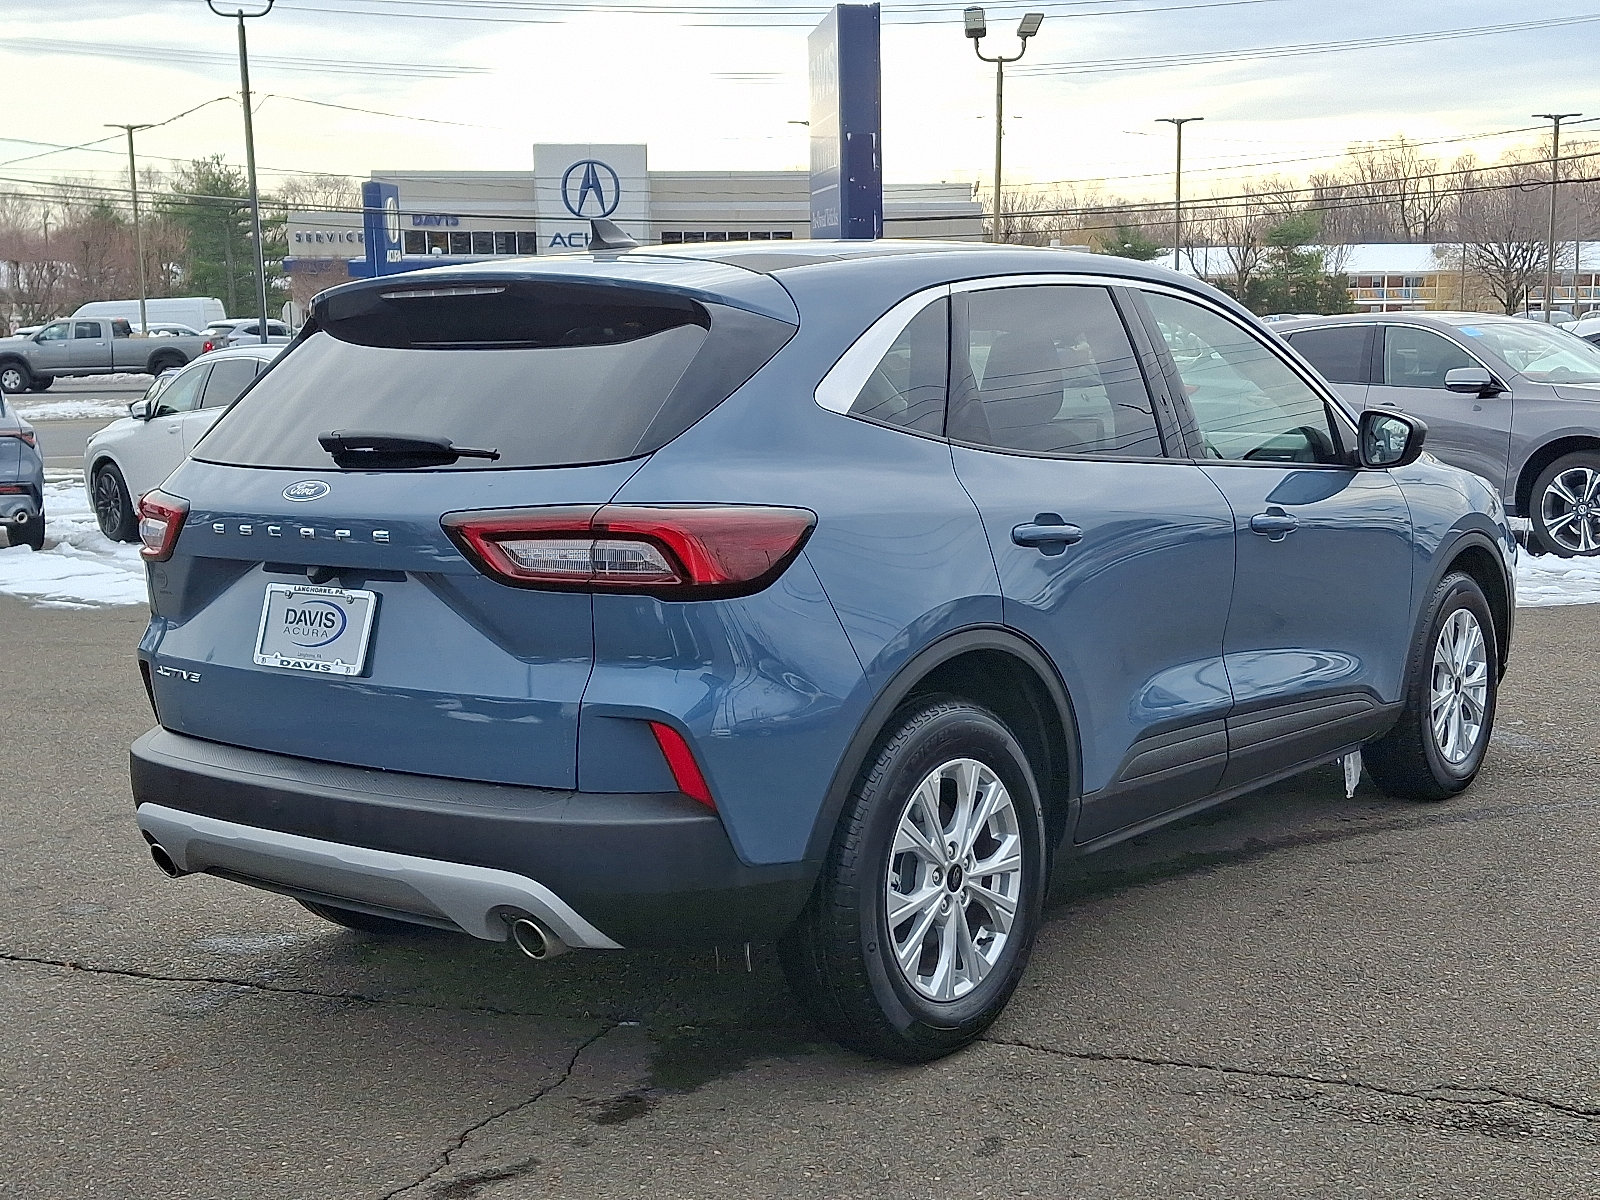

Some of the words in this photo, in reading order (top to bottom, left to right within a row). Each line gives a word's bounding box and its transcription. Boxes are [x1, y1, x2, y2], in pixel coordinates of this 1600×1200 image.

[412, 214, 459, 226] DAVIS
[295, 230, 364, 243] SERVICE
[290, 483, 319, 495] Ford
[212, 523, 390, 543] ESCAPE
[284, 609, 335, 628] DAVIS
[283, 626, 329, 638] ACURA
[279, 660, 331, 671] DAVIS
